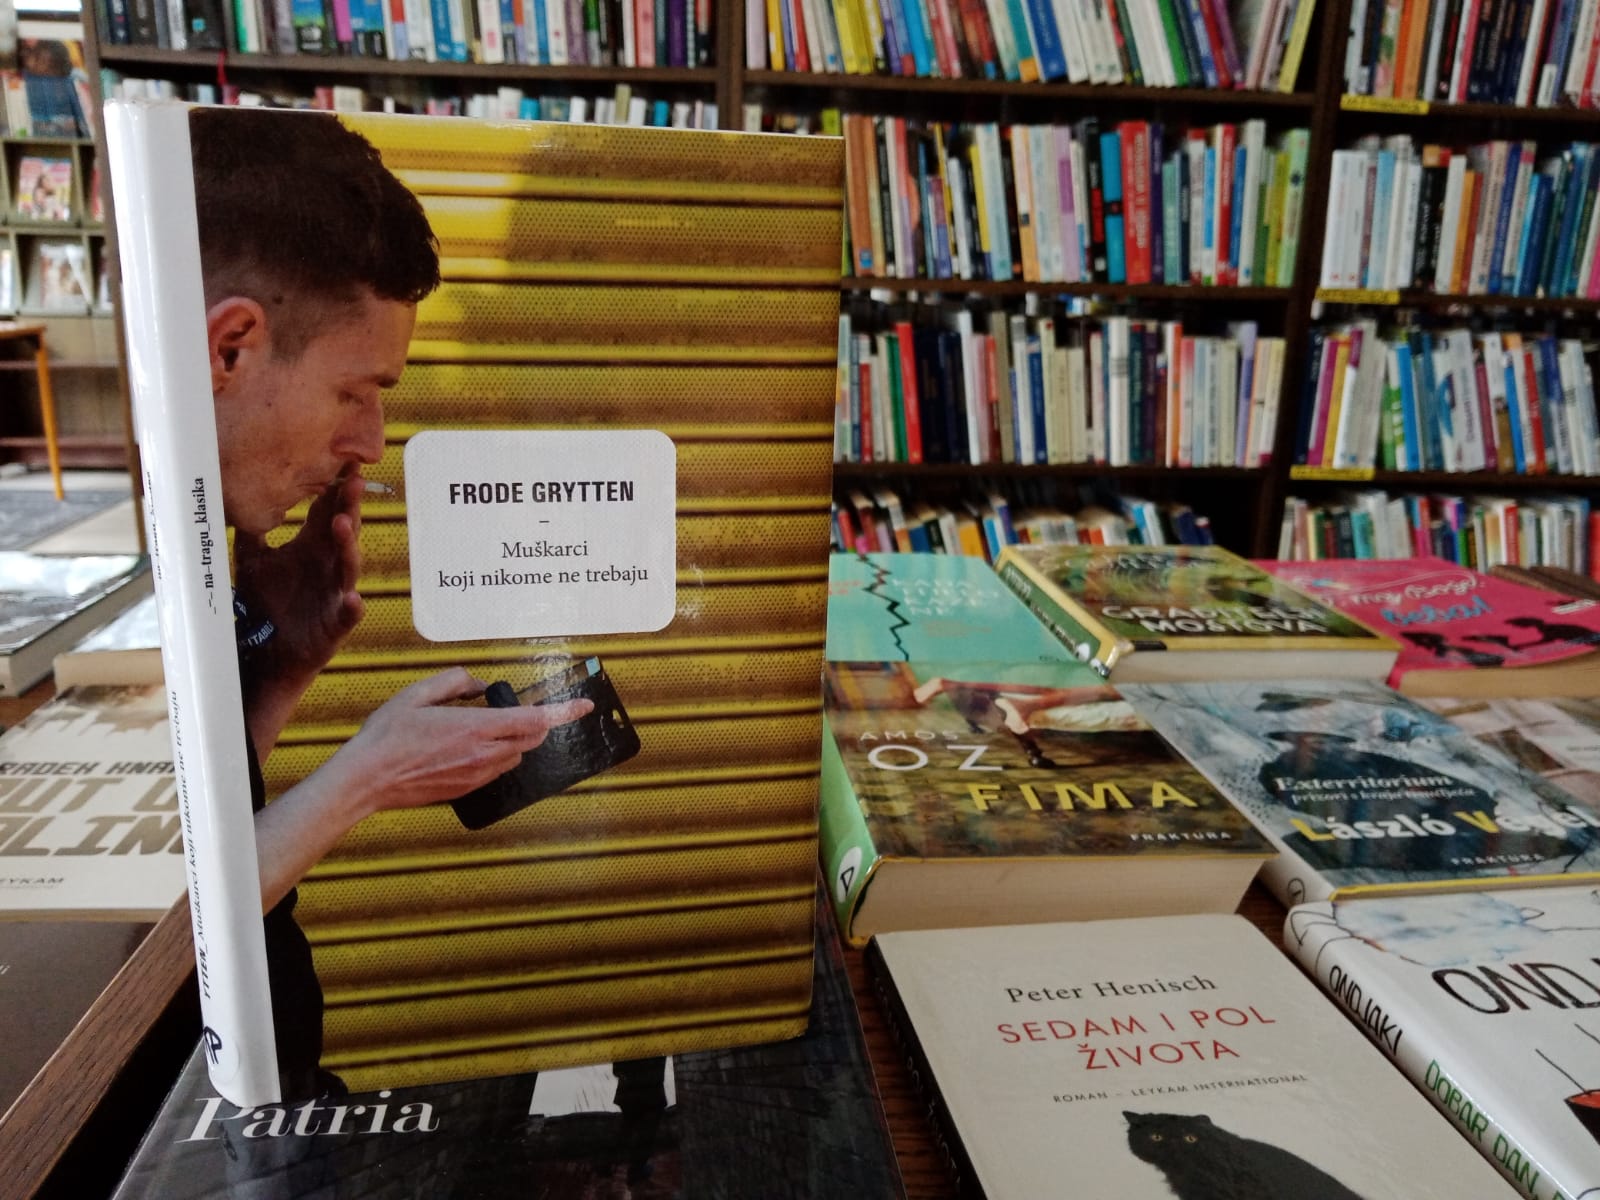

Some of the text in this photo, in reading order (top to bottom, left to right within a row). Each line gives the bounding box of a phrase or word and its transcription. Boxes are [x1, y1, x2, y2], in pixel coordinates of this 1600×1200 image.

[449, 480, 635, 505] FRODE GRYTTEN
[501, 541, 589, 559] Muškarci
[438, 565, 649, 592] koji nikome ne trebaju
[1139, 617, 1330, 635] MOSTOVA
[860, 730, 960, 741] AMOS
[867, 744, 1004, 772] OZ
[968, 781, 1199, 811] FIMA
[1273, 774, 1453, 791] Exterritorium
[1129, 831, 1233, 842] FRAKTURA
[1290, 813, 1456, 841] László
[1450, 853, 1545, 866] FRAKTURA
[1004, 974, 1219, 1003] Peter Henisch
[997, 1005, 1277, 1043] SEDAM I POL
[1329, 965, 1404, 1056] ONDJAKI
[1077, 1039, 1241, 1070] ŽIVOTA
[1053, 1073, 1309, 1103] ROMAN LEYKAM INTERNATIONAL
[1425, 1060, 1490, 1143] DOBAR
[173, 1090, 441, 1144] Patria
